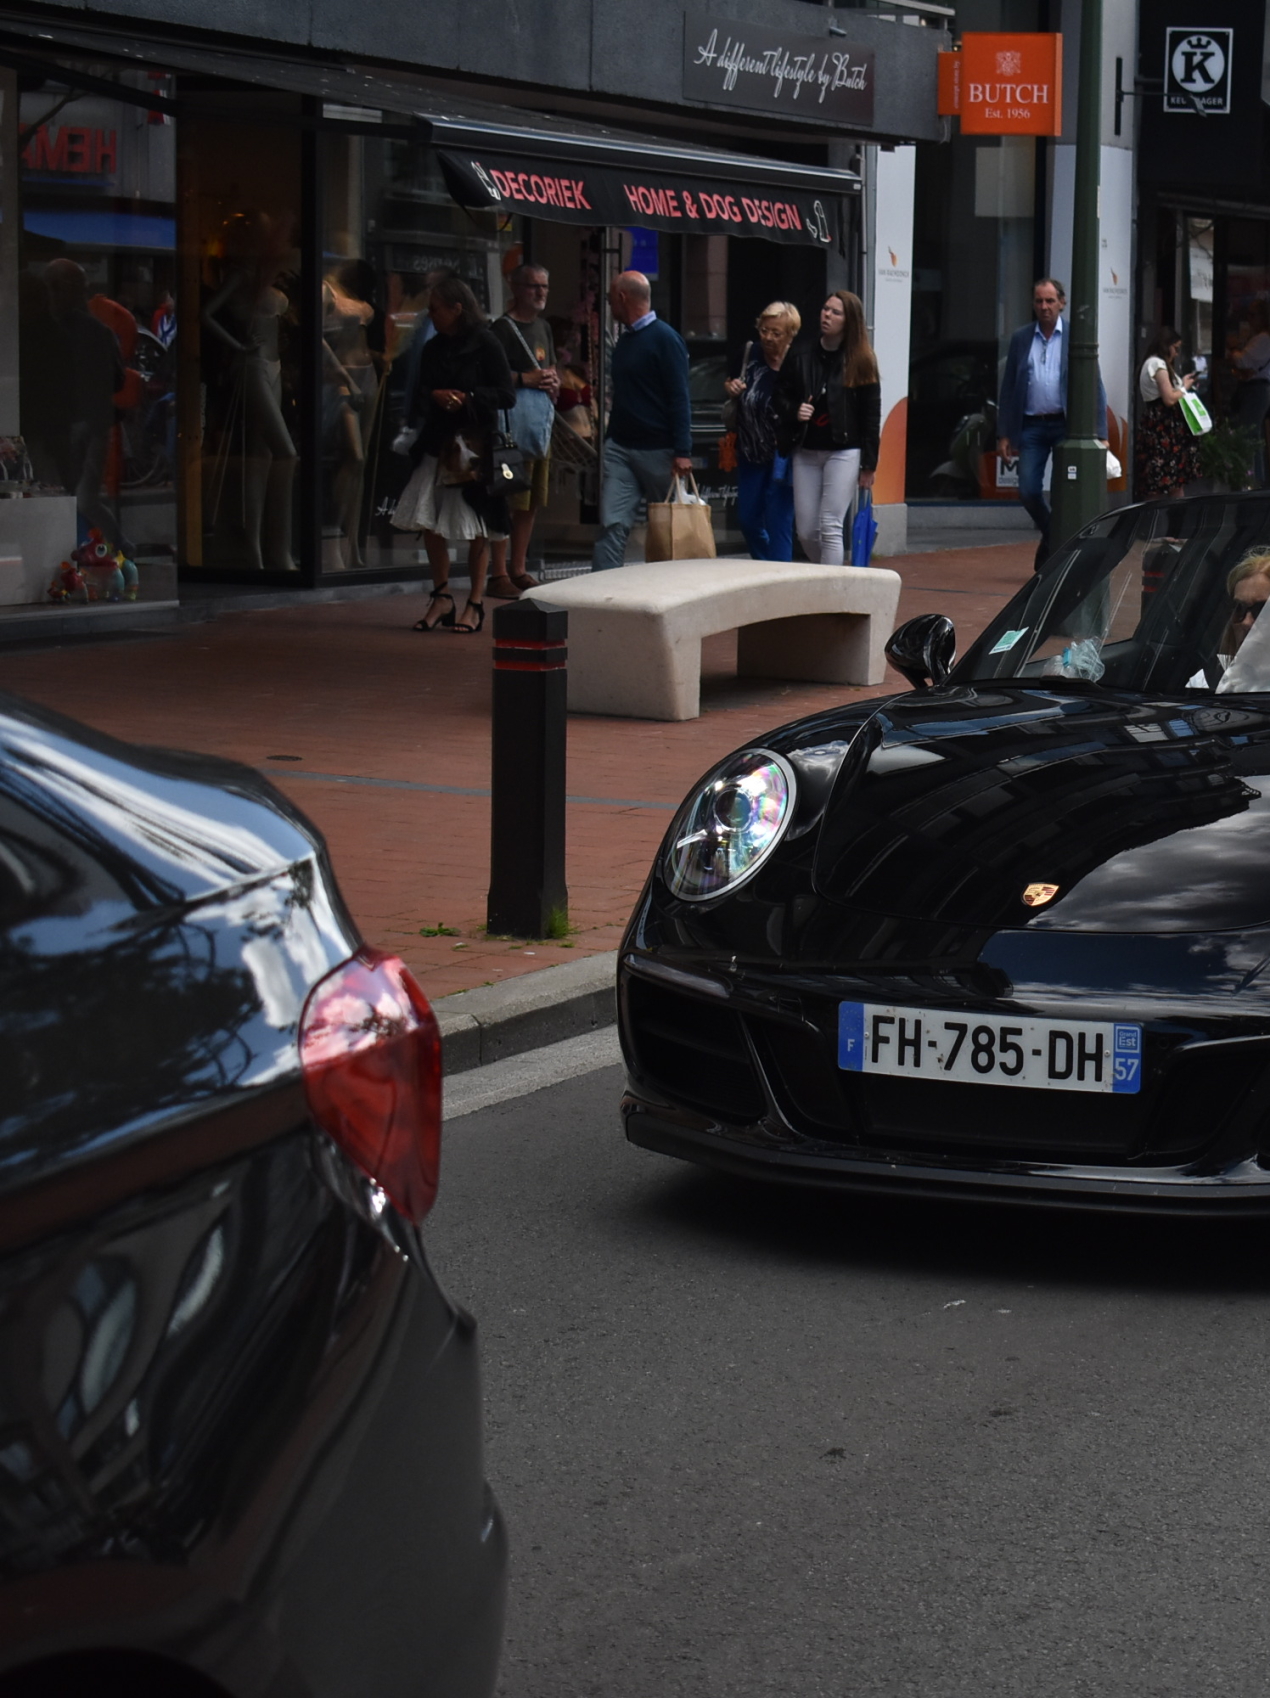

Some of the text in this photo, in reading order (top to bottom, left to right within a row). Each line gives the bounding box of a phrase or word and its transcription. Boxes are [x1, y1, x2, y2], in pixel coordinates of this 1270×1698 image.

[693, 28, 868, 104] A different lifestyle by Butch
[1181, 51, 1215, 84] K
[968, 83, 1049, 103] BUTCH
[1170, 97, 1223, 105] KEUAGER
[984, 108, 1030, 119] Est. 1956
[489, 168, 802, 230] DECORIEK HOME & DOG DESIGN
[847, 1038, 856, 1052] F
[871, 1014, 1103, 1082] FH-785-DH
[1119, 1037, 1137, 1047] Est
[1115, 1057, 1139, 1081] 57
